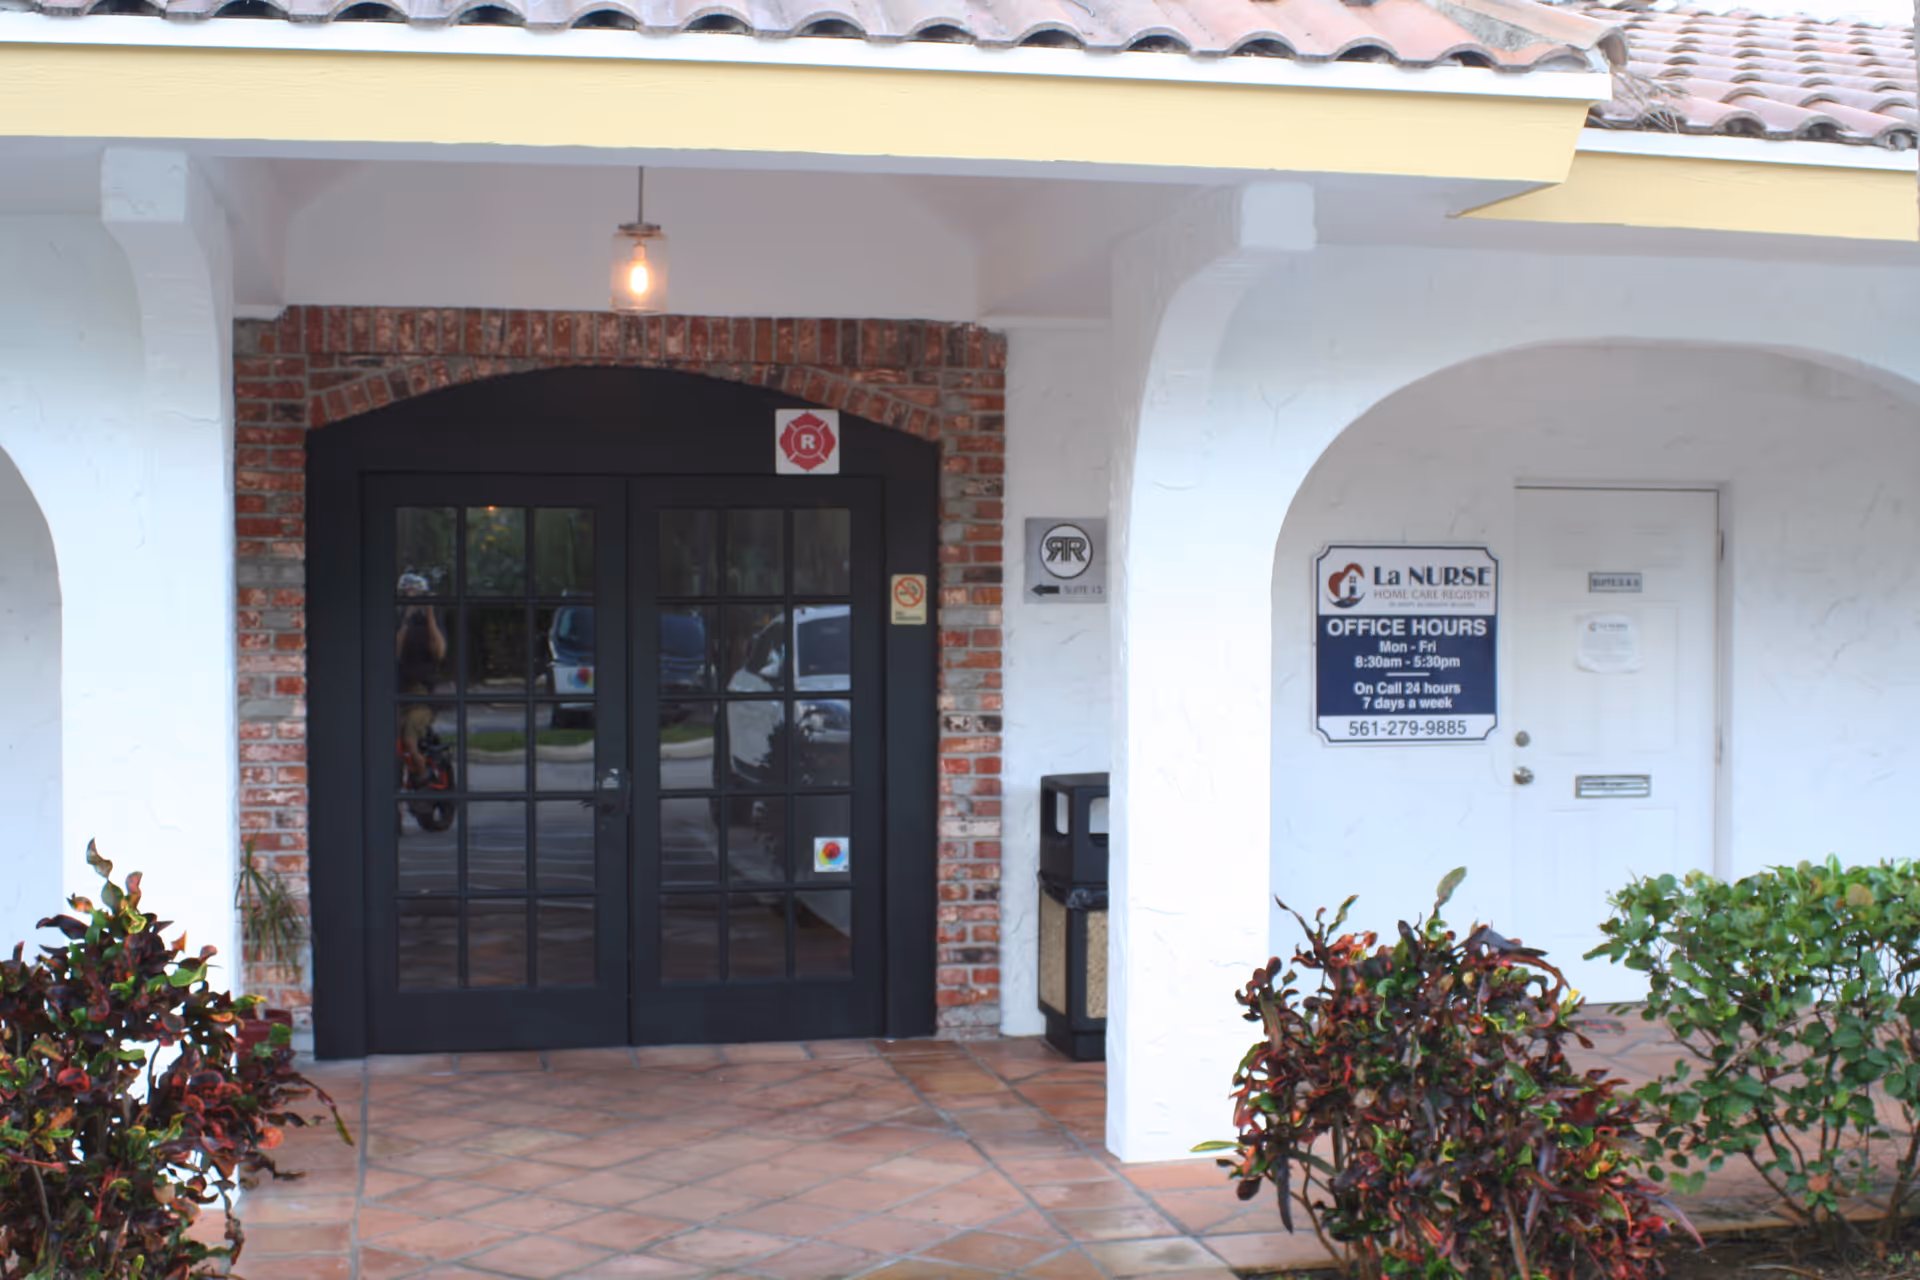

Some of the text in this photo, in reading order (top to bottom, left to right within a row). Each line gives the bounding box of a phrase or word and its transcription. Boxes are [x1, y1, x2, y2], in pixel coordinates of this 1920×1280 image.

[800, 433, 816, 450] R
[1373, 566, 1492, 586] La NURSE
[1373, 589, 1491, 600] HOME CARE REGISTRY
[1327, 618, 1488, 636] OFFICE HOURS
[1379, 641, 1408, 653] Mon
[1418, 640, 1437, 653] Fri
[1354, 656, 1402, 668] 8:30am
[1413, 656, 1461, 670] 5:30pm
[1353, 681, 1461, 695] On Call 24 hours
[1362, 696, 1453, 712] 7 days a week
[1348, 719, 1467, 736] 561-279-9885
